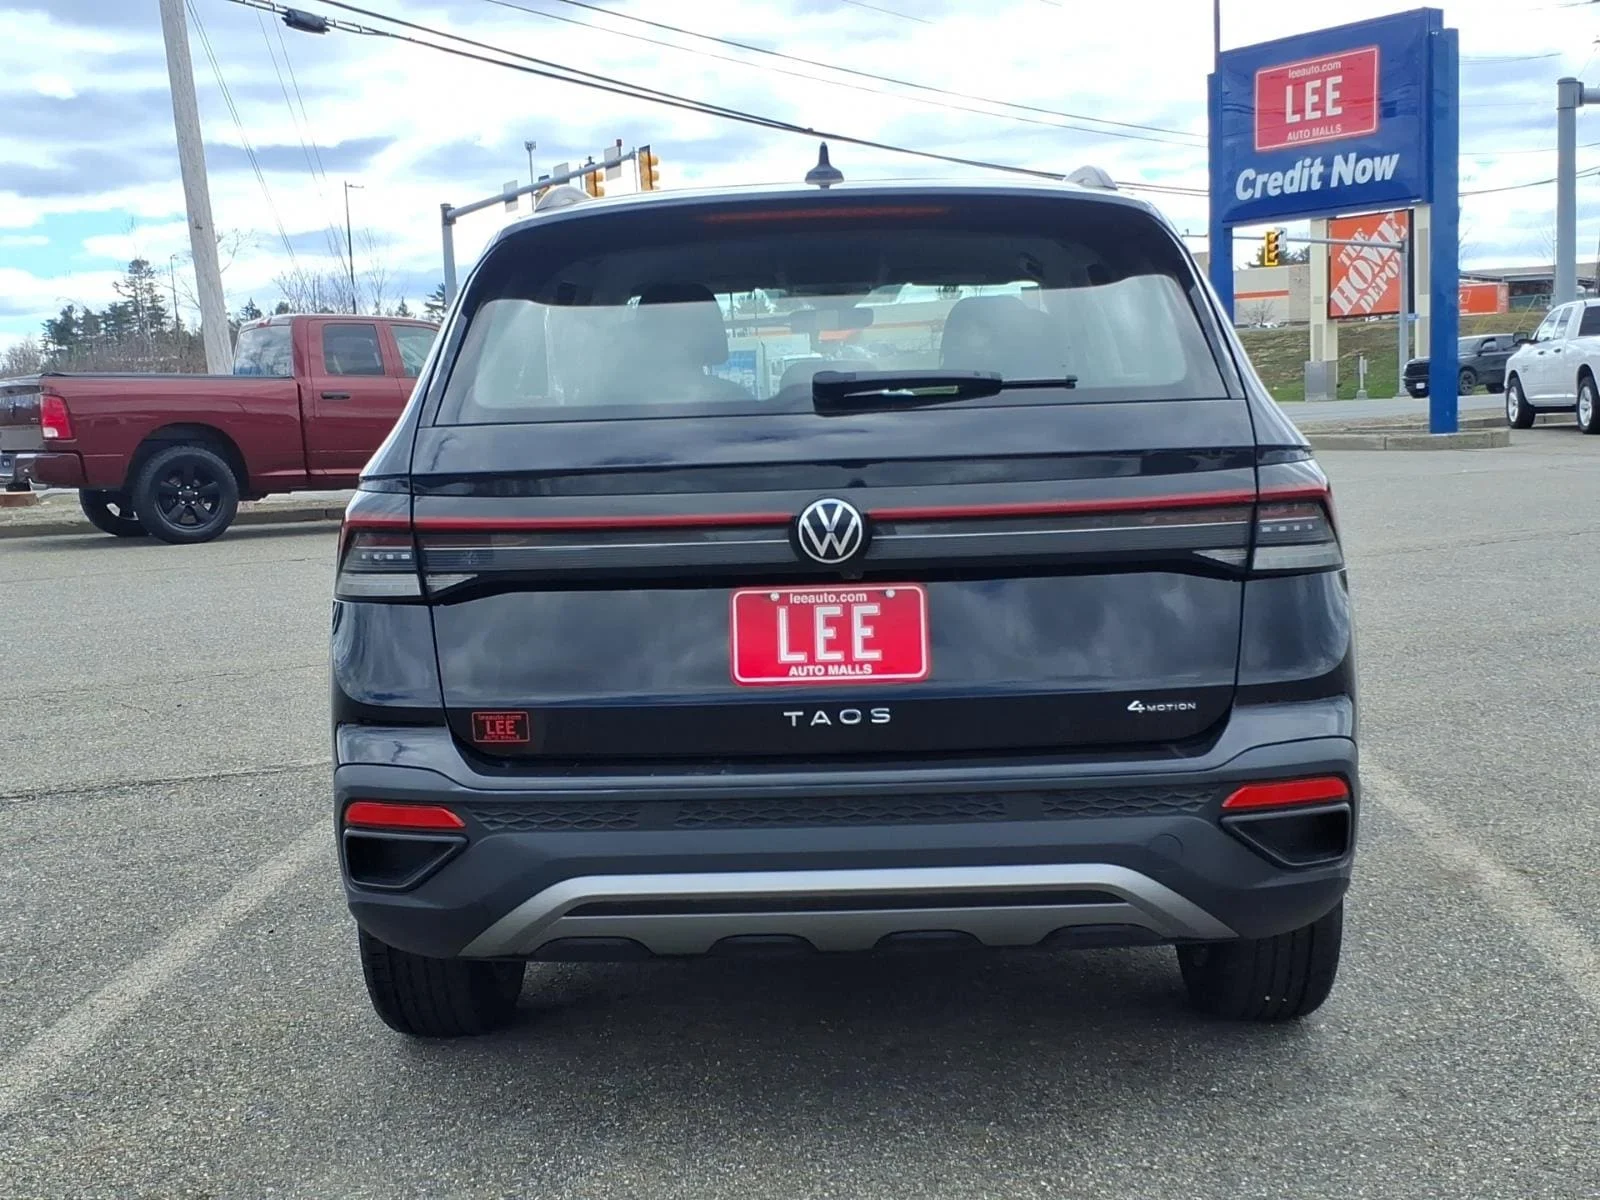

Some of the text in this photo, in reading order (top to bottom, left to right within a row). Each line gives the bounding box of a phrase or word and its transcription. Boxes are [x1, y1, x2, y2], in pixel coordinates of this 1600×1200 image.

[1288, 60, 1342, 79] leeauto.com
[1285, 75, 1343, 124] LEE
[1287, 123, 1342, 142] AUTO MALLS
[1235, 152, 1400, 201] Credit Now
[789, 592, 867, 604] leeauto.com
[777, 603, 883, 664] LEE
[788, 663, 873, 677] AUTO MALLS
[783, 707, 892, 727] TAOS
[486, 720, 516, 735] LEE
